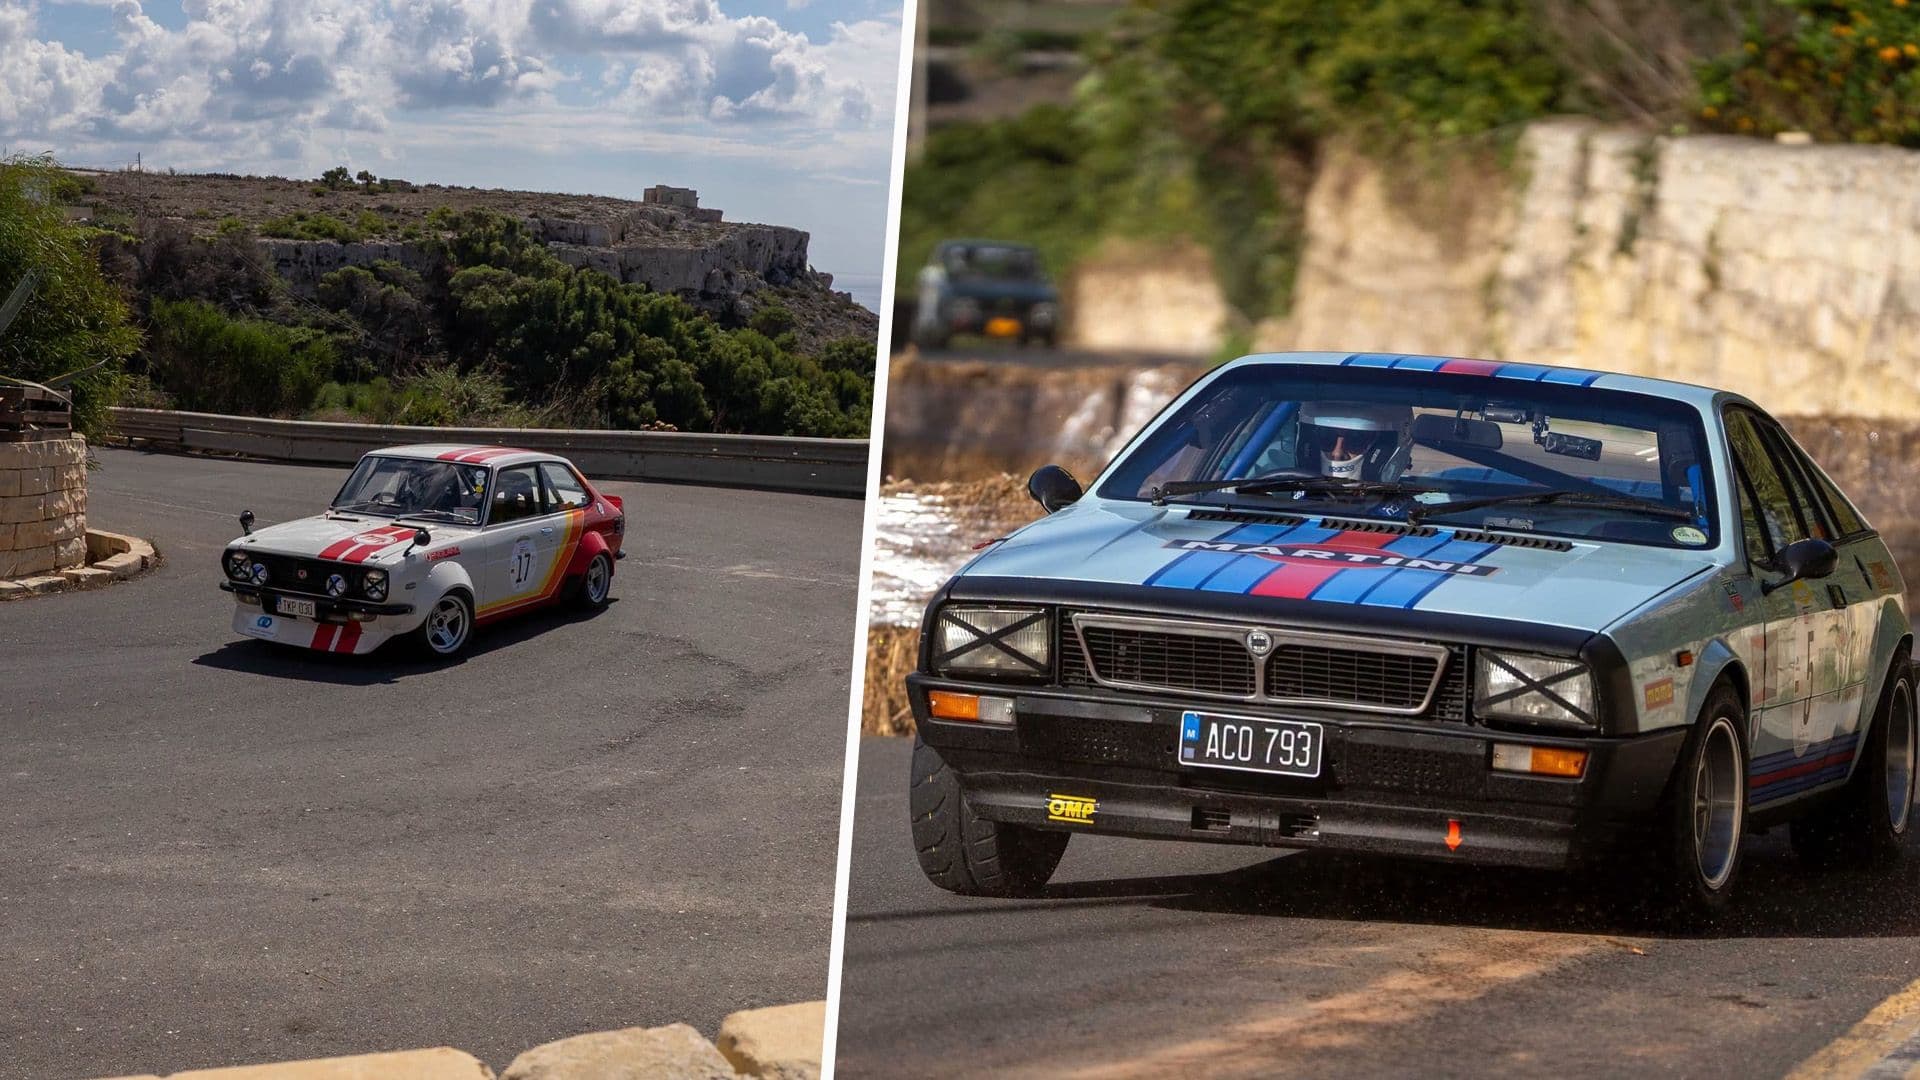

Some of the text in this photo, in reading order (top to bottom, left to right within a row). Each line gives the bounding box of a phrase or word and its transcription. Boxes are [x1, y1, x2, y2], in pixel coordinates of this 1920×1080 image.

[515, 553, 531, 584] 17
[1181, 540, 1479, 574] MARTINI
[283, 600, 297, 613] TKP
[299, 601, 313, 616] 030
[1264, 727, 1312, 767] 793
[1048, 799, 1096, 818] OMP
